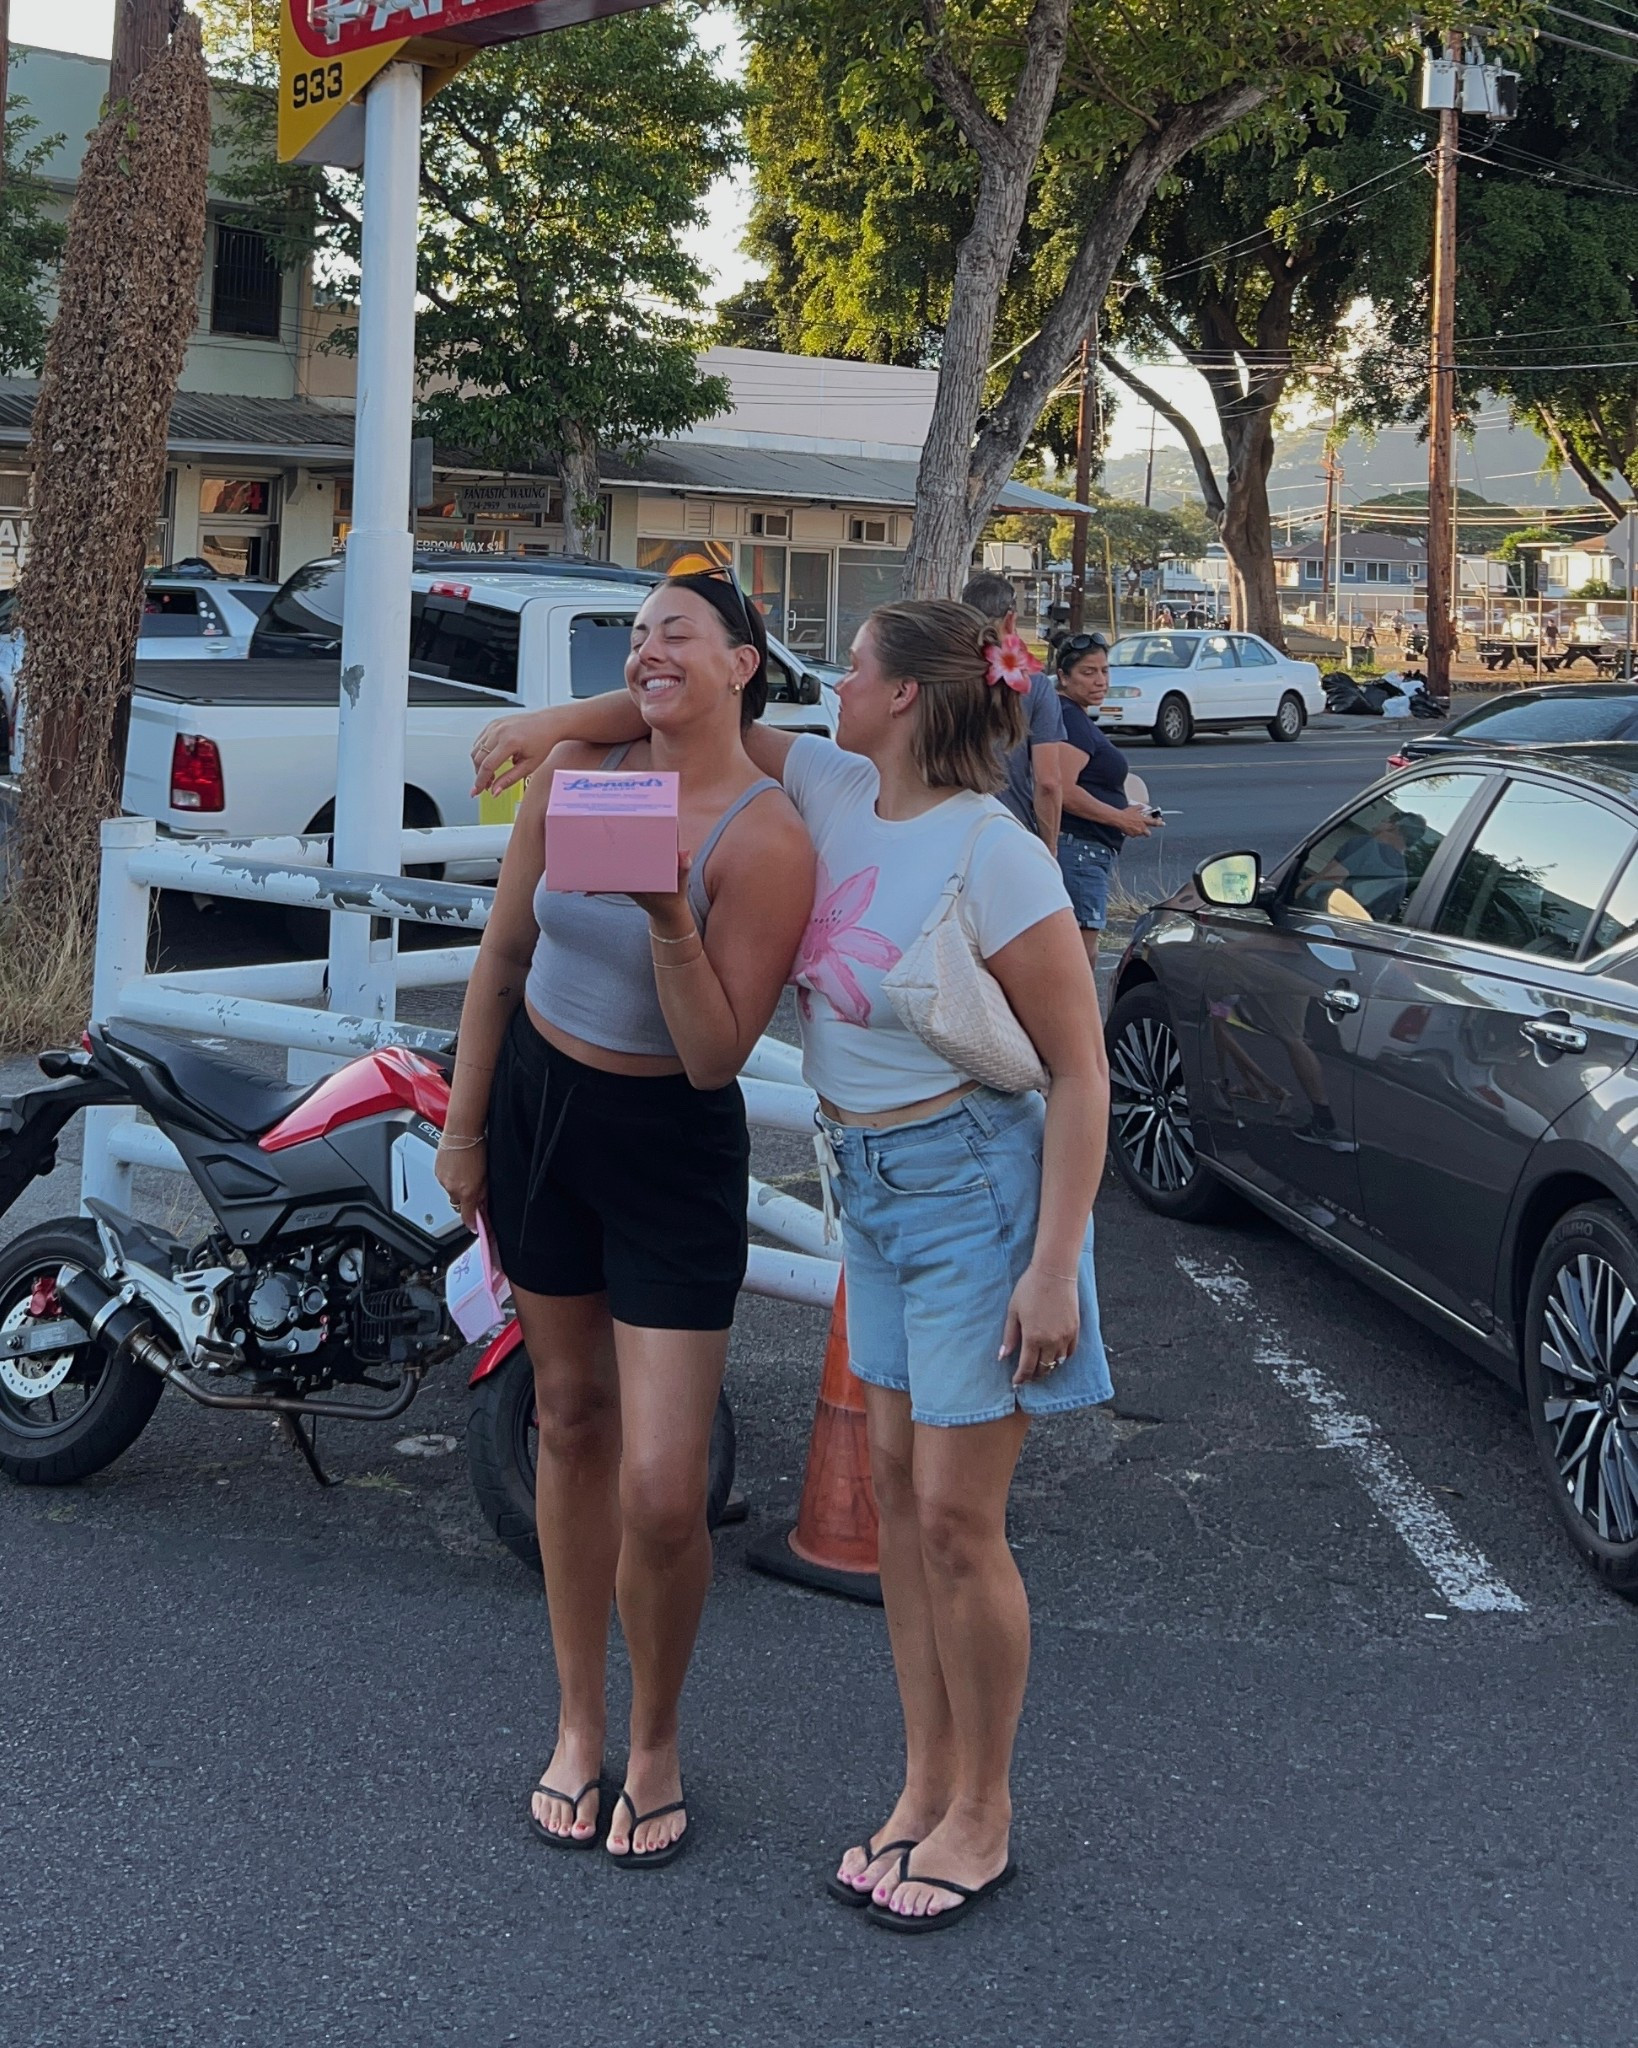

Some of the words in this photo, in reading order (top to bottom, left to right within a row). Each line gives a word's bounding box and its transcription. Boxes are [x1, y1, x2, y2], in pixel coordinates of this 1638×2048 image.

[293, 61, 343, 109] 933
[463, 486, 509, 499] FANTASTIC
[510, 486, 545, 498] WAXING
[460, 541, 484, 553] WAX
[562, 777, 664, 791] Leonard's
